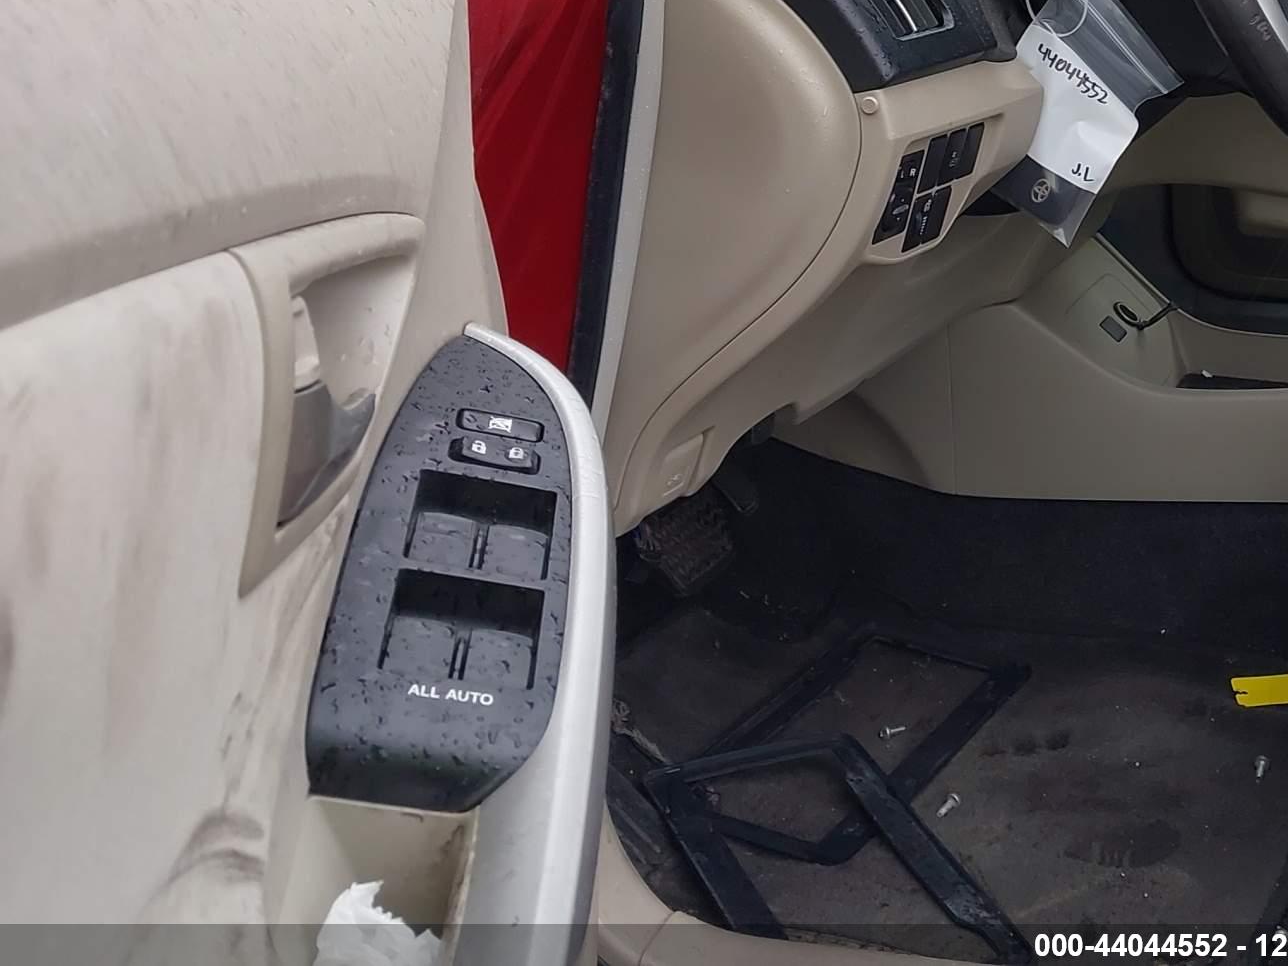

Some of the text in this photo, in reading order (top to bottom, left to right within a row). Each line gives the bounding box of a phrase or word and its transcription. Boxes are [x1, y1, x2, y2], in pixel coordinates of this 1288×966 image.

[1037, 43, 1108, 105] 44044552
[407, 683, 494, 706] ALL AUTO
